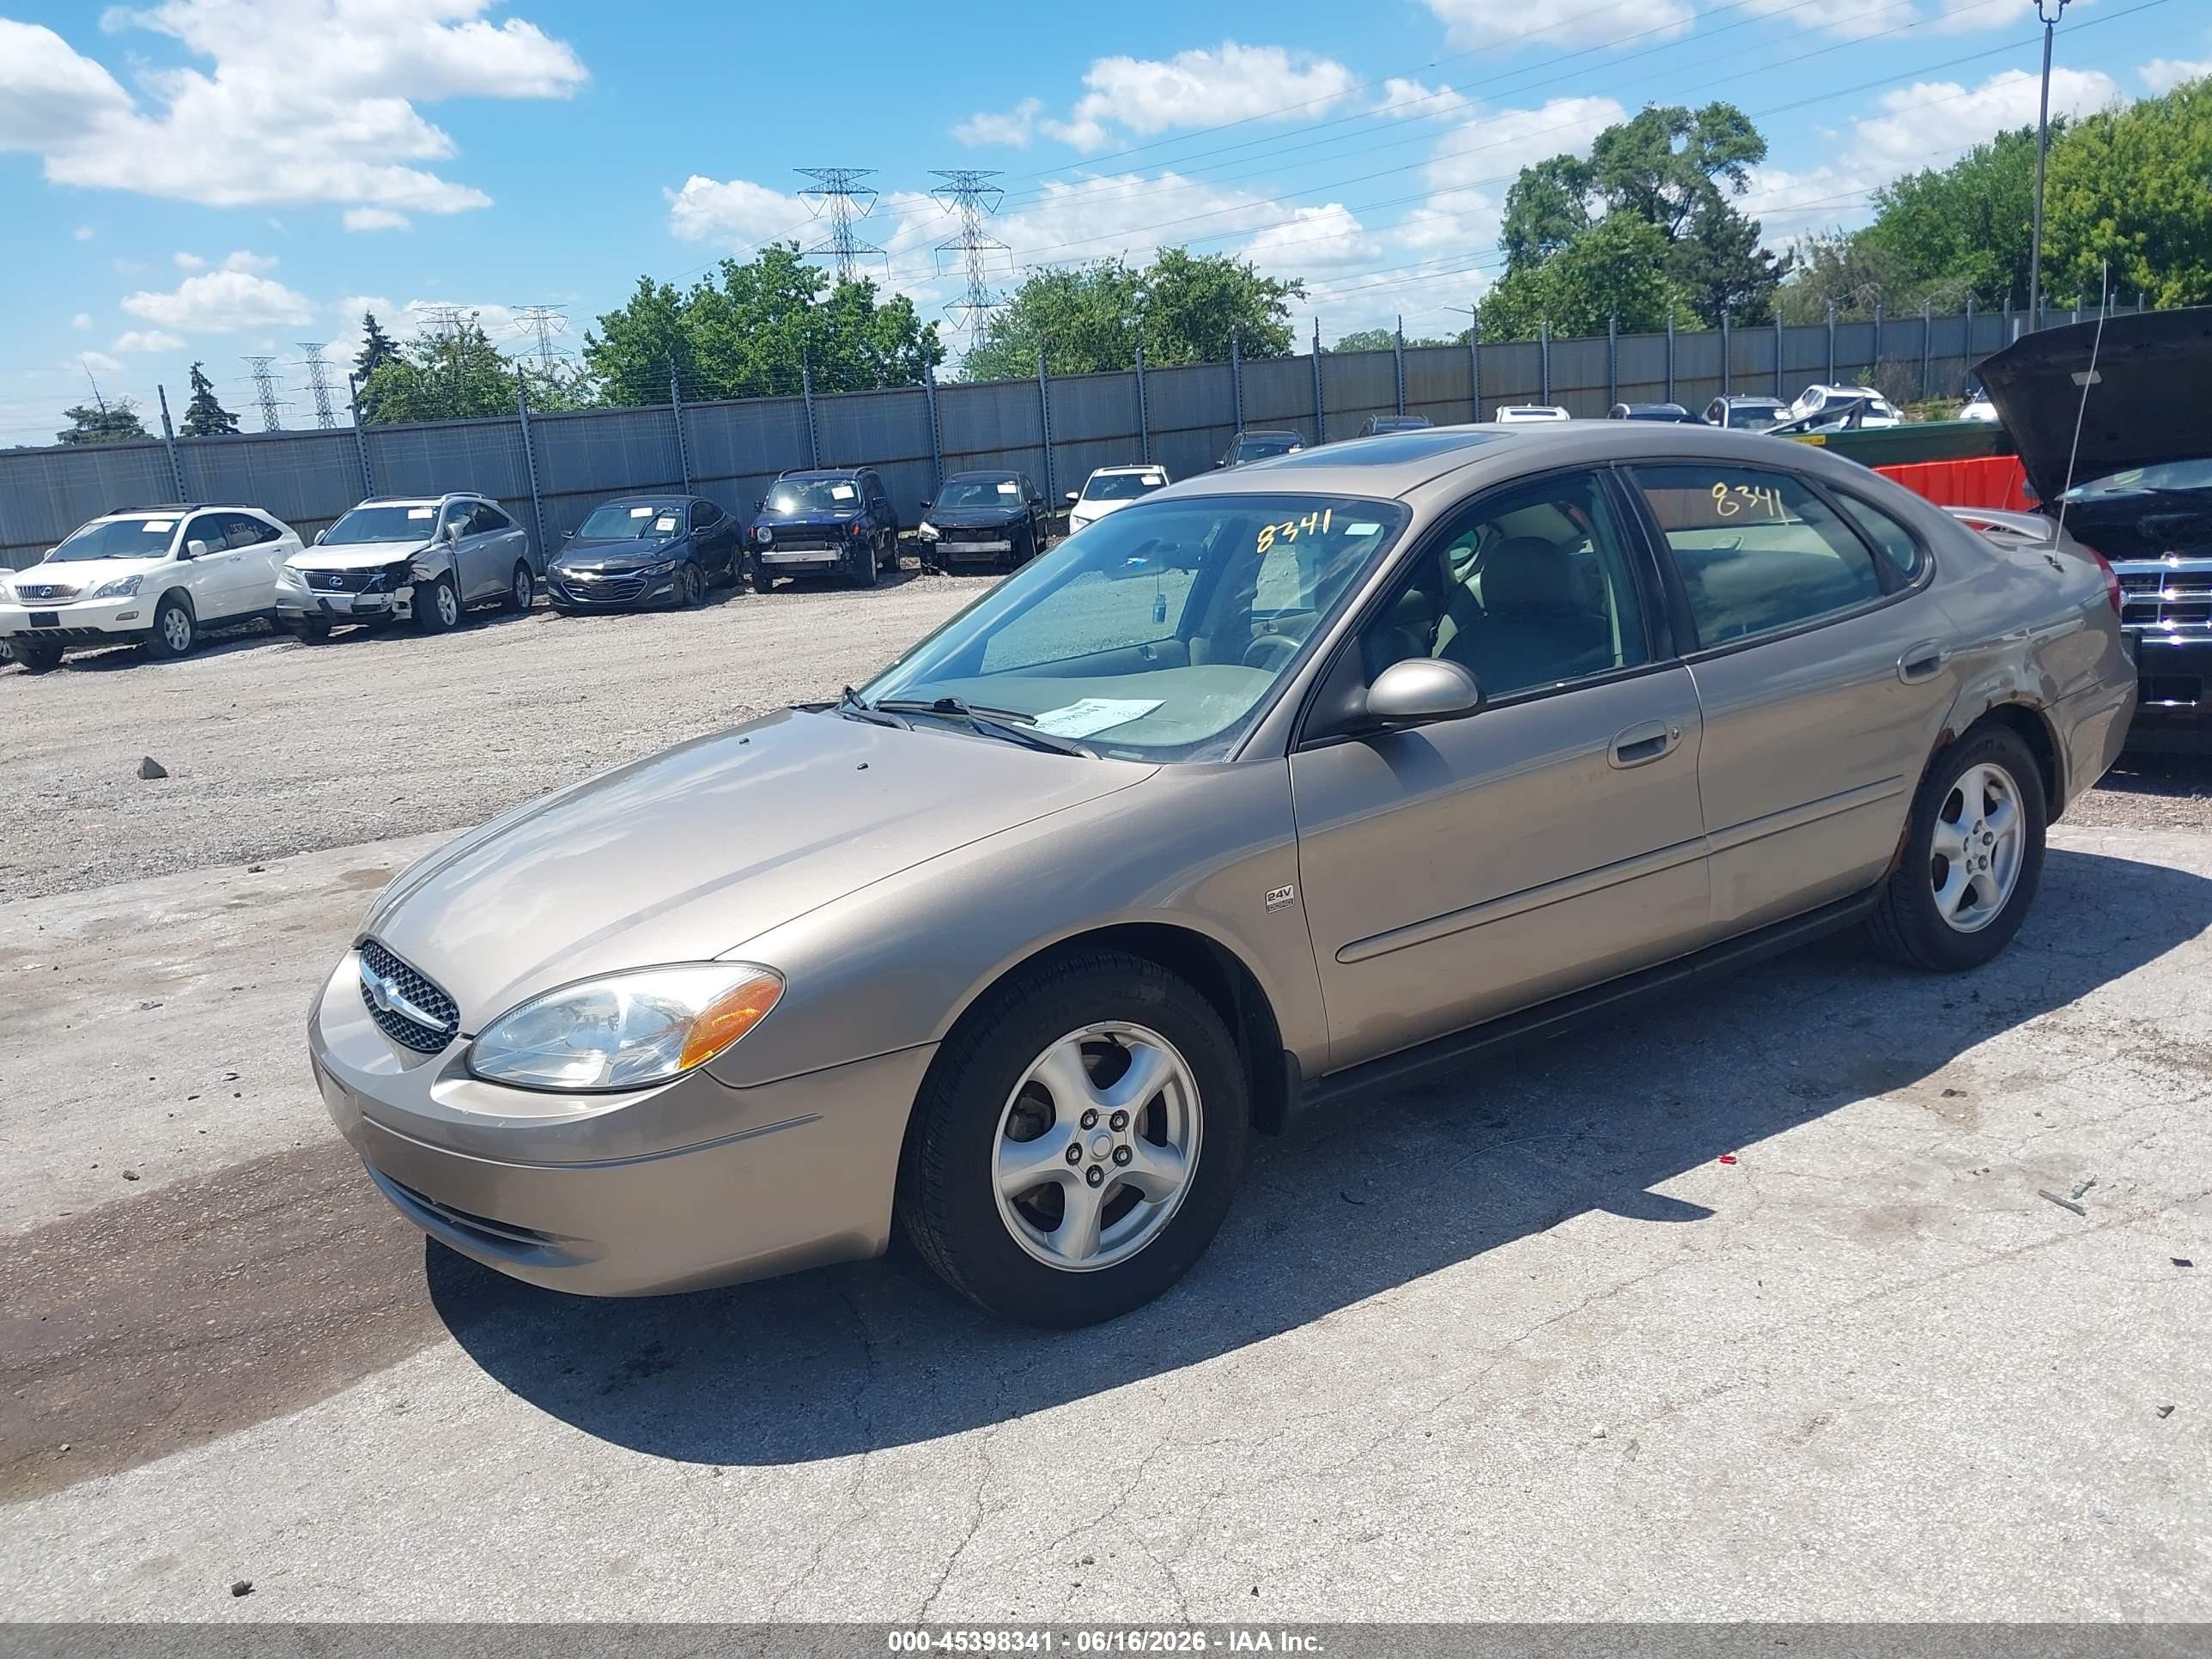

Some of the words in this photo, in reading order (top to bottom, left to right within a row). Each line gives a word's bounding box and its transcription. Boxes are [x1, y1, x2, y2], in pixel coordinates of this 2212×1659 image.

[1711, 482, 1789, 526] 8341
[1256, 508, 1332, 554] 8341
[1267, 886, 1292, 902] 24V
